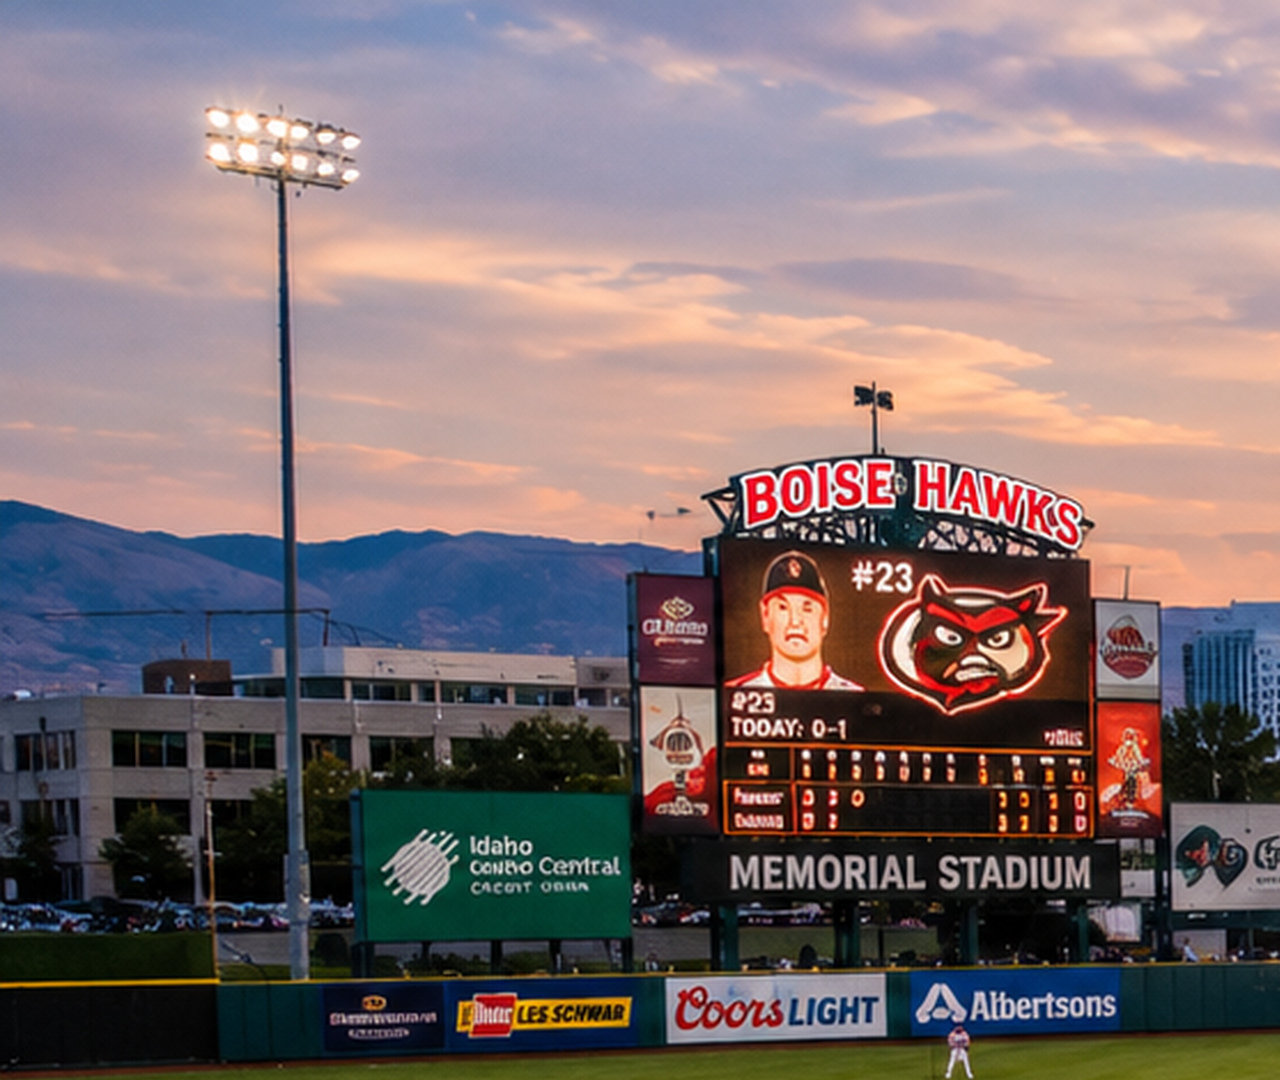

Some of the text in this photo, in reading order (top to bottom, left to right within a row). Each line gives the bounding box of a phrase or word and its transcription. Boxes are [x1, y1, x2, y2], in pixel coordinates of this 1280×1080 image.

[741, 459, 1083, 549] BOISE HAWKS
[851, 561, 914, 594] #23
[731, 717, 847, 740] TODAY: 0-1
[470, 836, 533, 855] Idaho
[730, 855, 1092, 891] MEMORIAL STADIUM
[516, 1005, 548, 1025] LES
[675, 986, 880, 1030] Coors LIGHT
[970, 990, 1117, 1021] Albertsons
